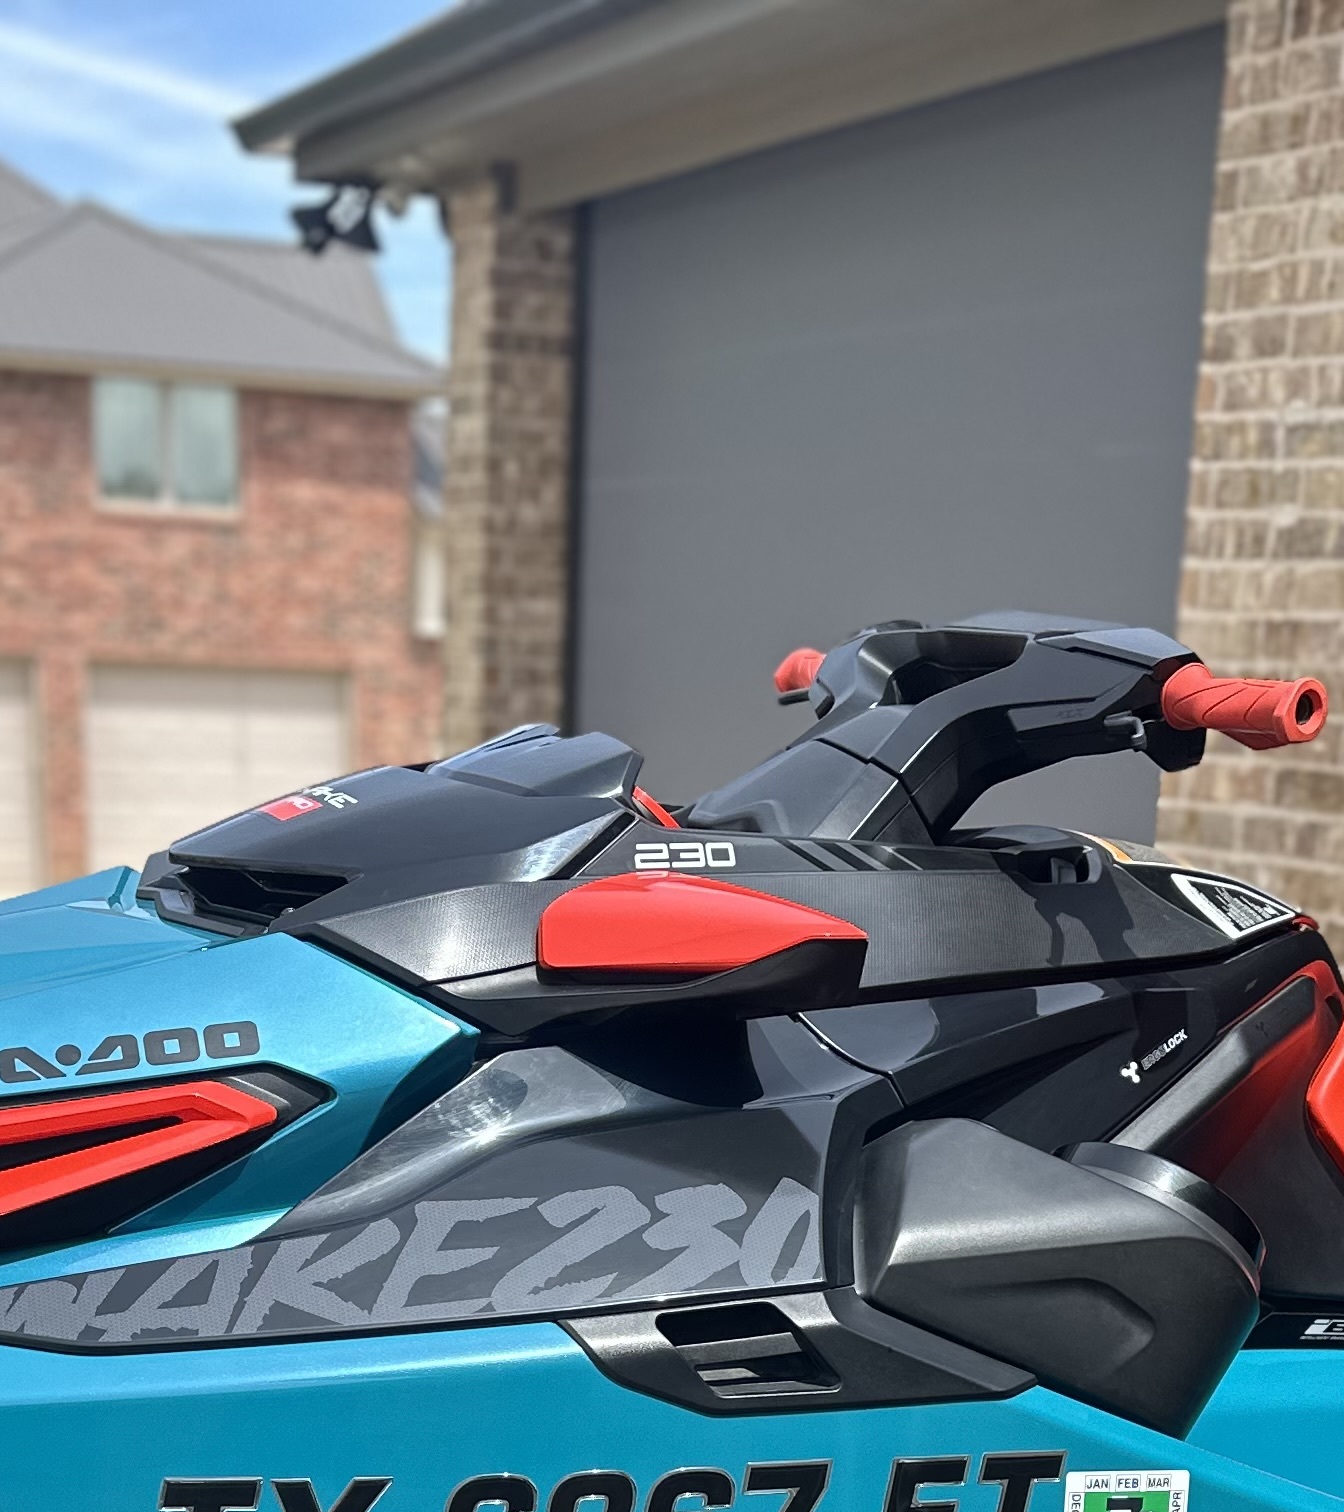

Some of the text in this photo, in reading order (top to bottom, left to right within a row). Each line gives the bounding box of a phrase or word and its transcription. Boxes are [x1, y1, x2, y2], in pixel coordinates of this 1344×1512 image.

[634, 842, 737, 869] 230
[1086, 1477, 1170, 1490] JAN FEB MAR
